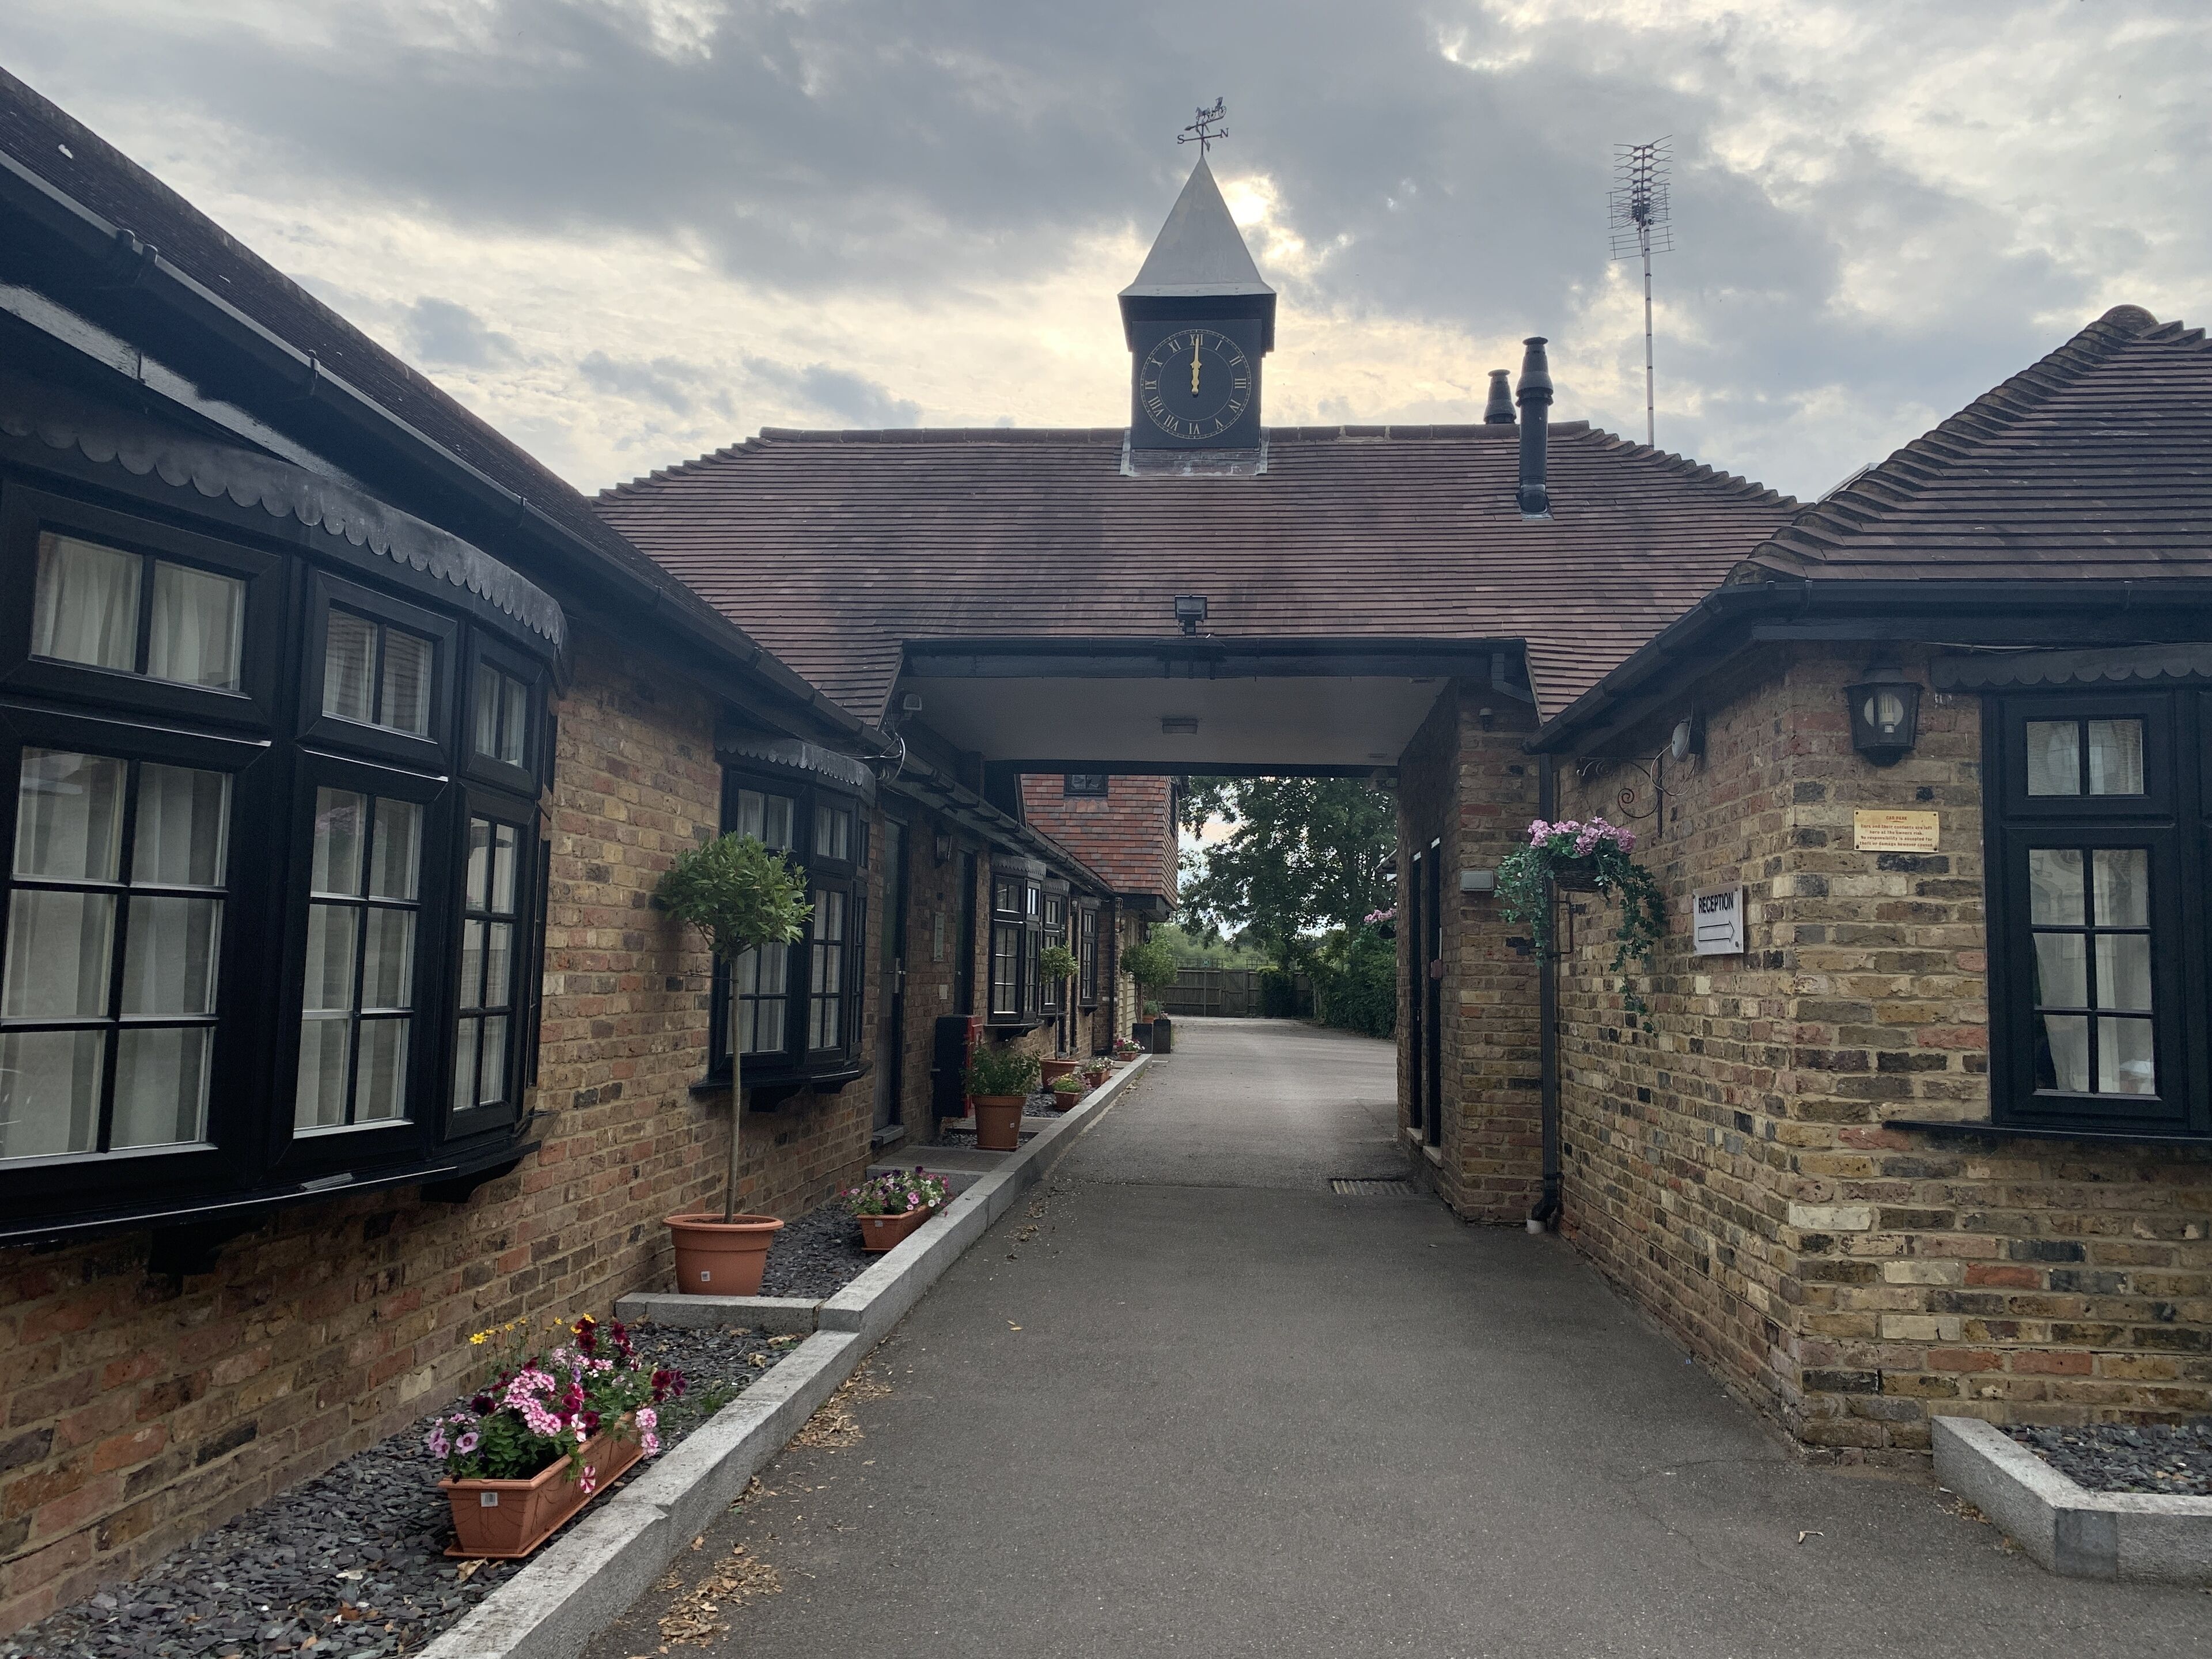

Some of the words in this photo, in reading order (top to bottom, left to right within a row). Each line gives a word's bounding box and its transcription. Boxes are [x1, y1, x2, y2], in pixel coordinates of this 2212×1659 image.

[1219, 127, 1229, 138] N
[1177, 134, 1185, 144] S
[1168, 339, 1181, 353] XI
[1151, 357, 1164, 368] X
[1229, 355, 1243, 367] II
[1145, 380, 1157, 390] IX
[1234, 378, 1247, 389] III
[1148, 396, 1165, 417] VIII
[1228, 399, 1241, 414] IV
[1164, 414, 1179, 431] VII
[1189, 423, 1200, 434] VI
[1215, 418, 1224, 430] V
[1698, 892, 1734, 914] RECEPTION
